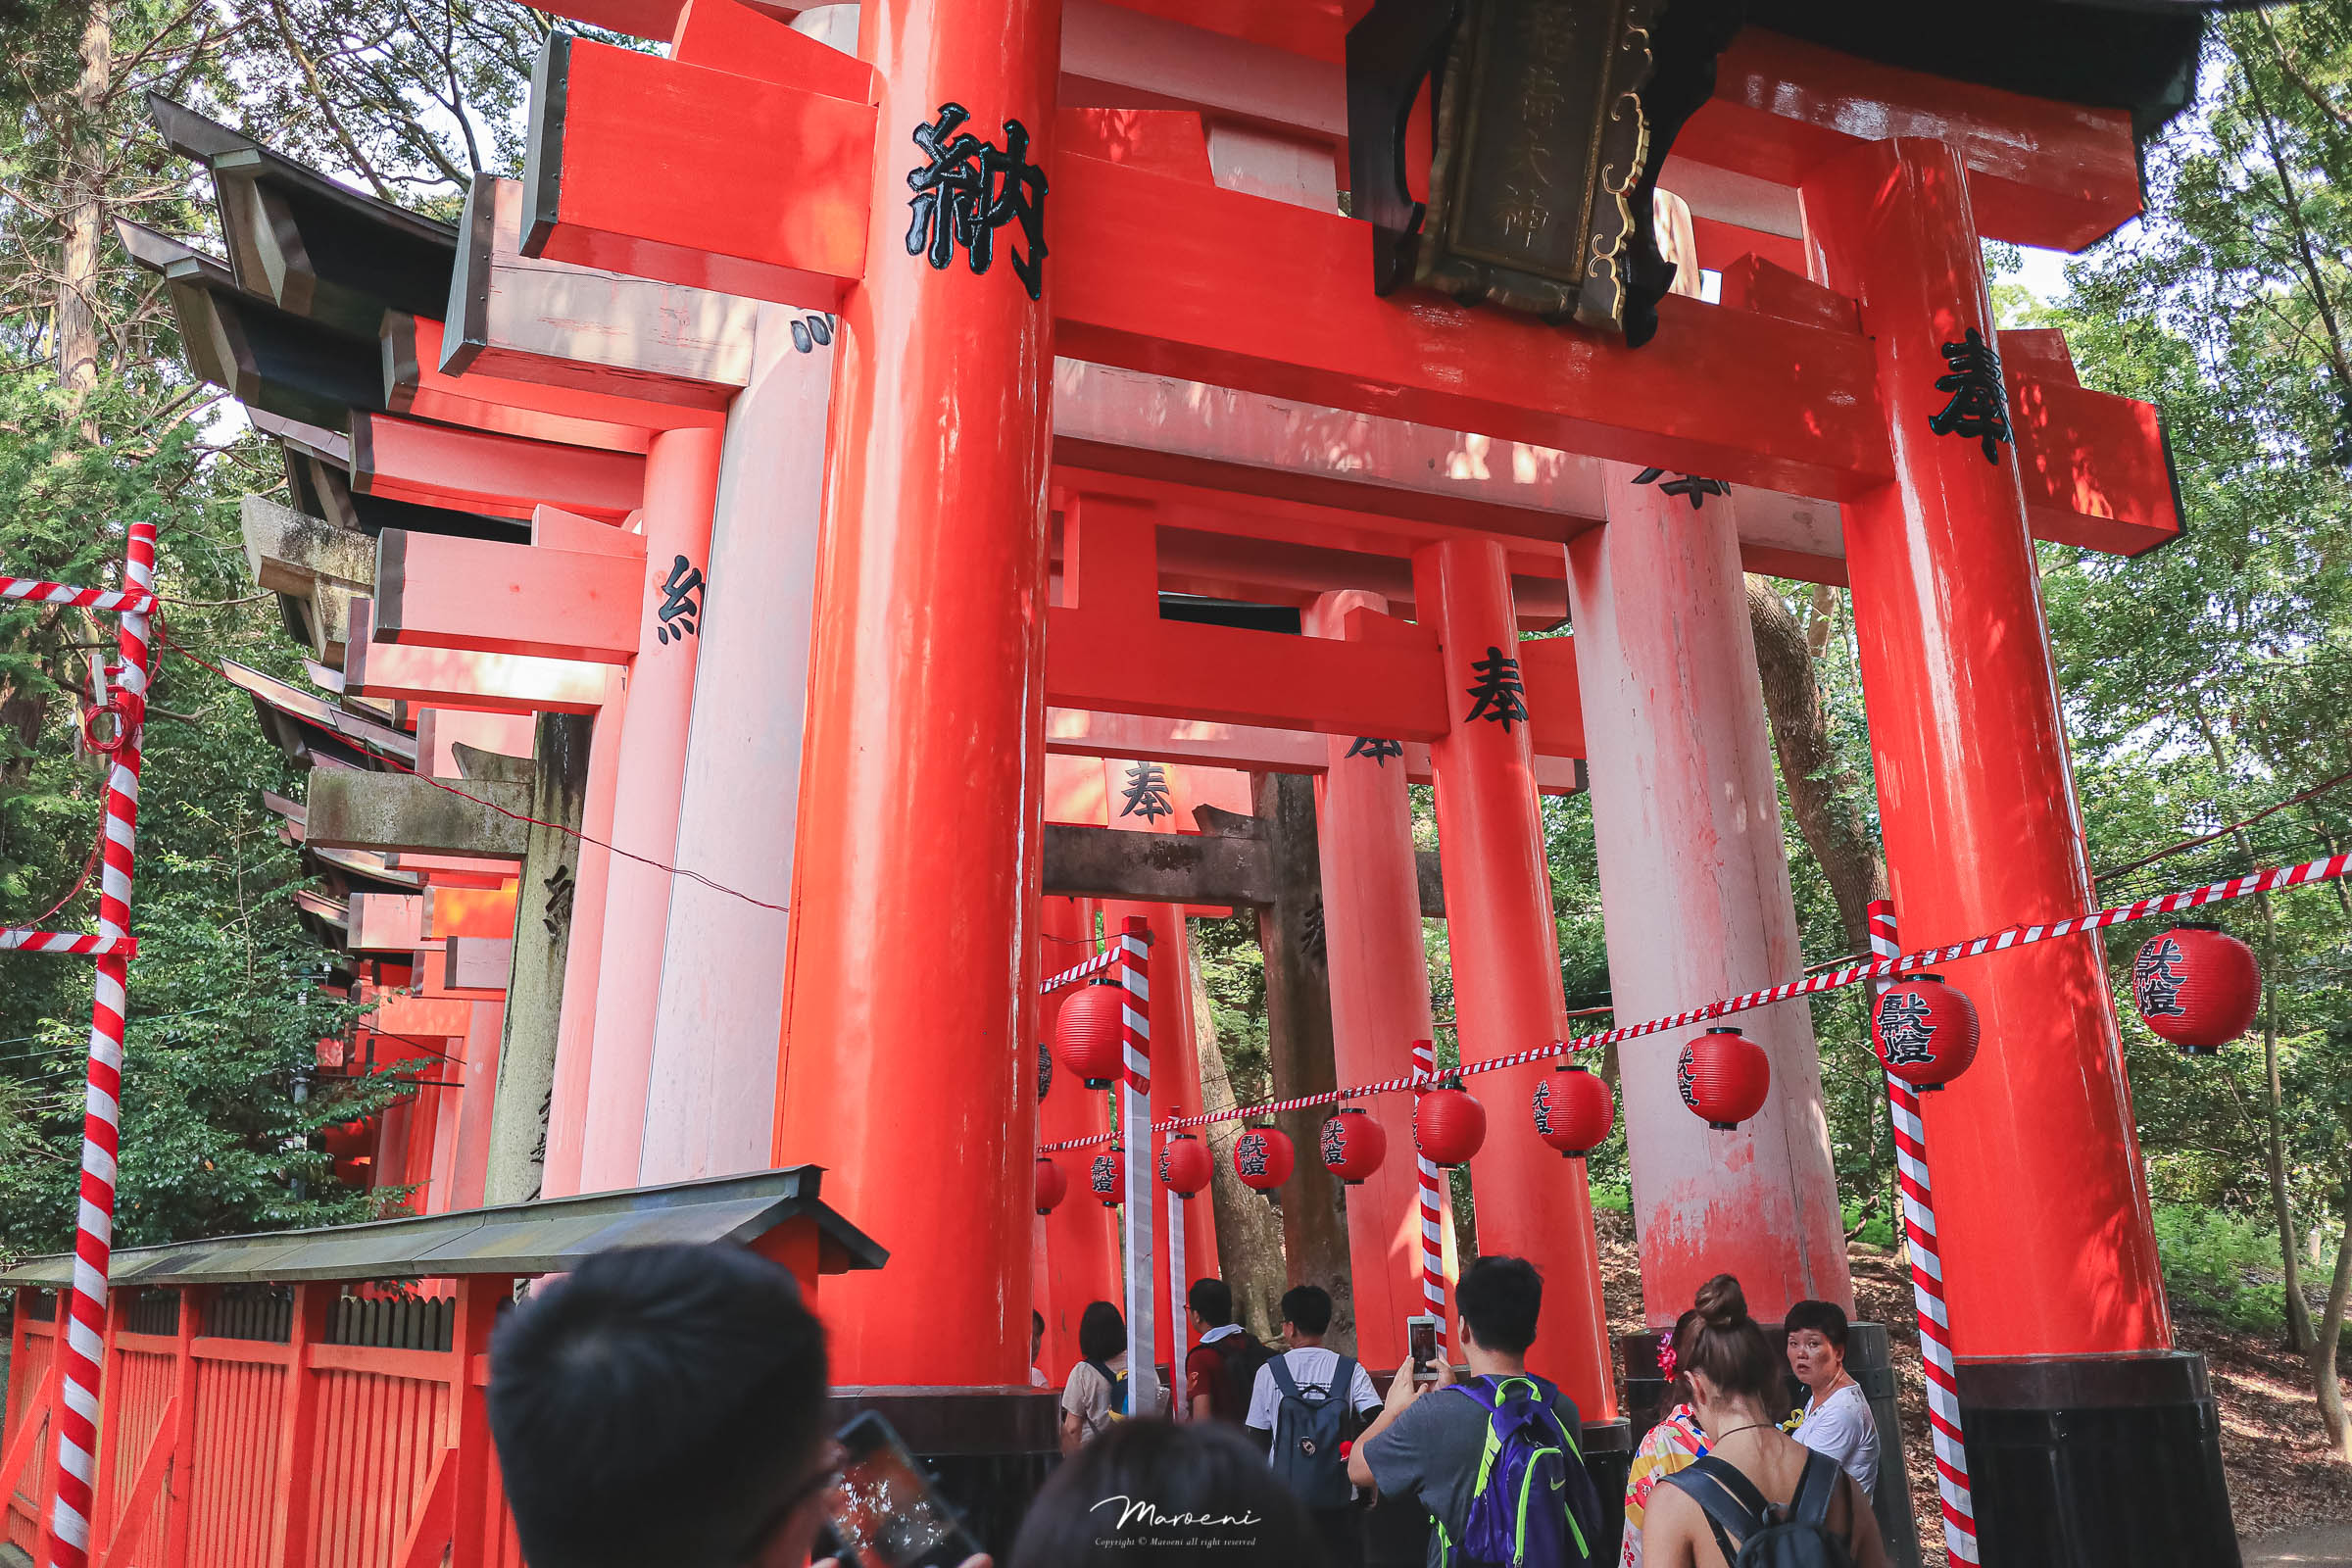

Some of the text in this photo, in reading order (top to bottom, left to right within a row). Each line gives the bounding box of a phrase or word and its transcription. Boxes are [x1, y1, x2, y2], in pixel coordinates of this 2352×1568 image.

[905, 101, 1050, 301] 納
[1928, 326, 2019, 466] 奉
[1464, 646, 1530, 734] 奉
[1119, 760, 1174, 826] 奉
